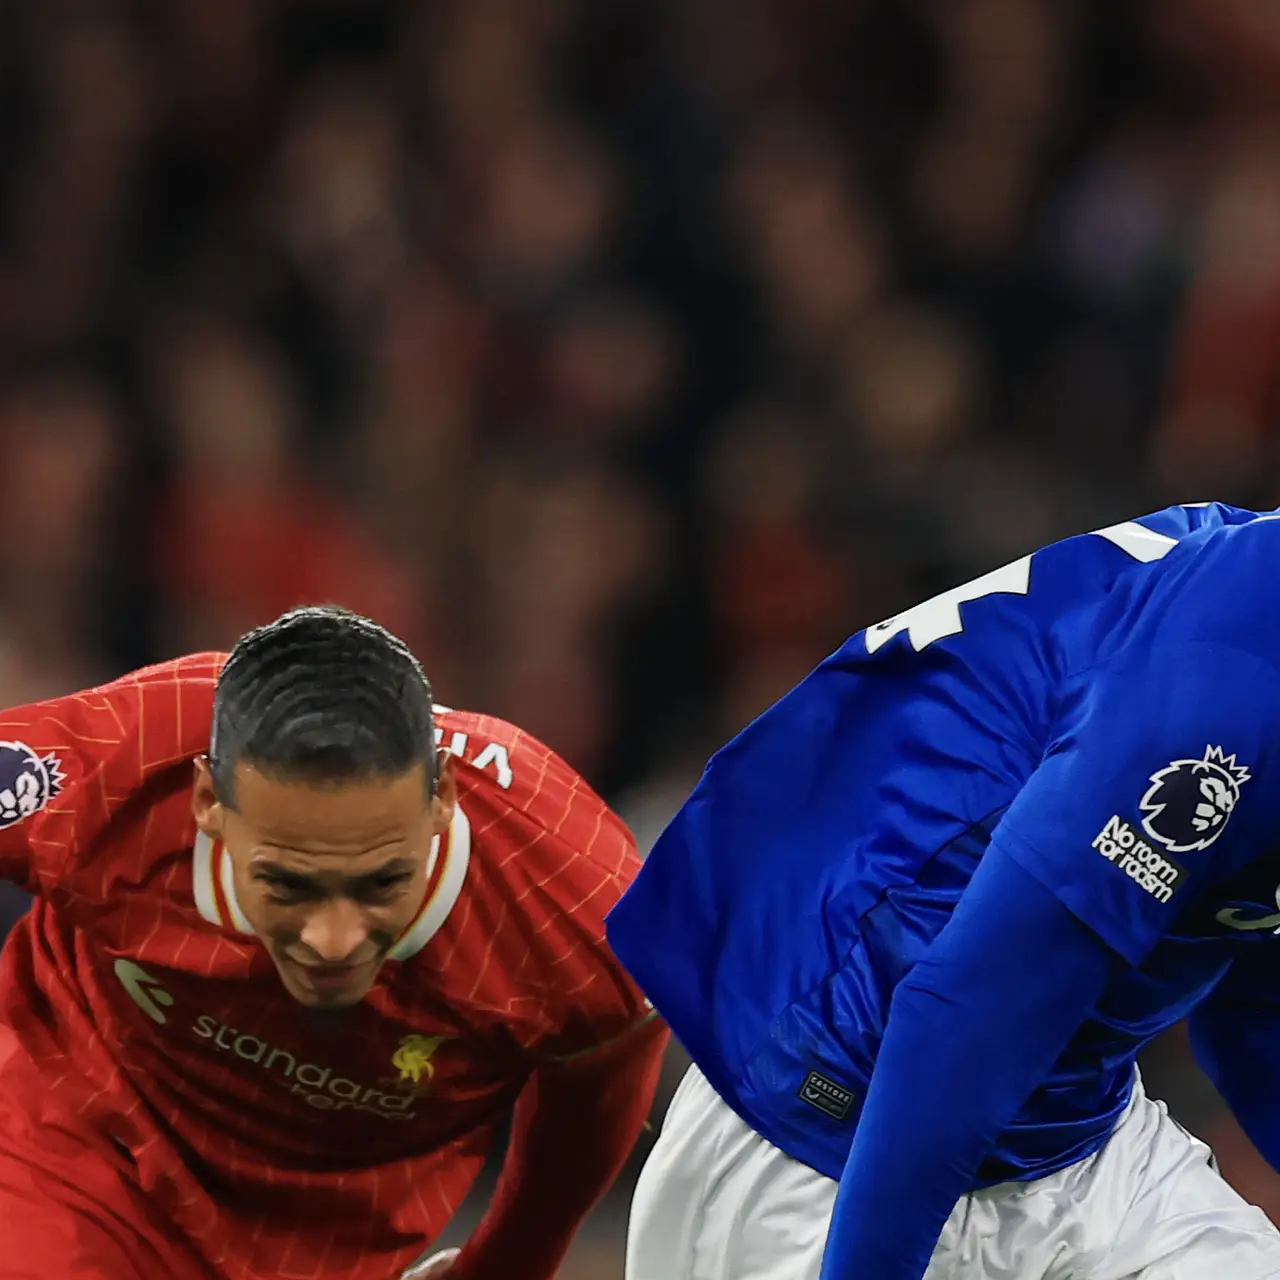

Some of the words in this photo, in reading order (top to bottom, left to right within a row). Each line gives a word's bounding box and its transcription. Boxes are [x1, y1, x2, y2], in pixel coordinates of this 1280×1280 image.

[1102, 814, 1136, 848] No
[1131, 840, 1179, 884] room
[1118, 853, 1174, 903] racism
